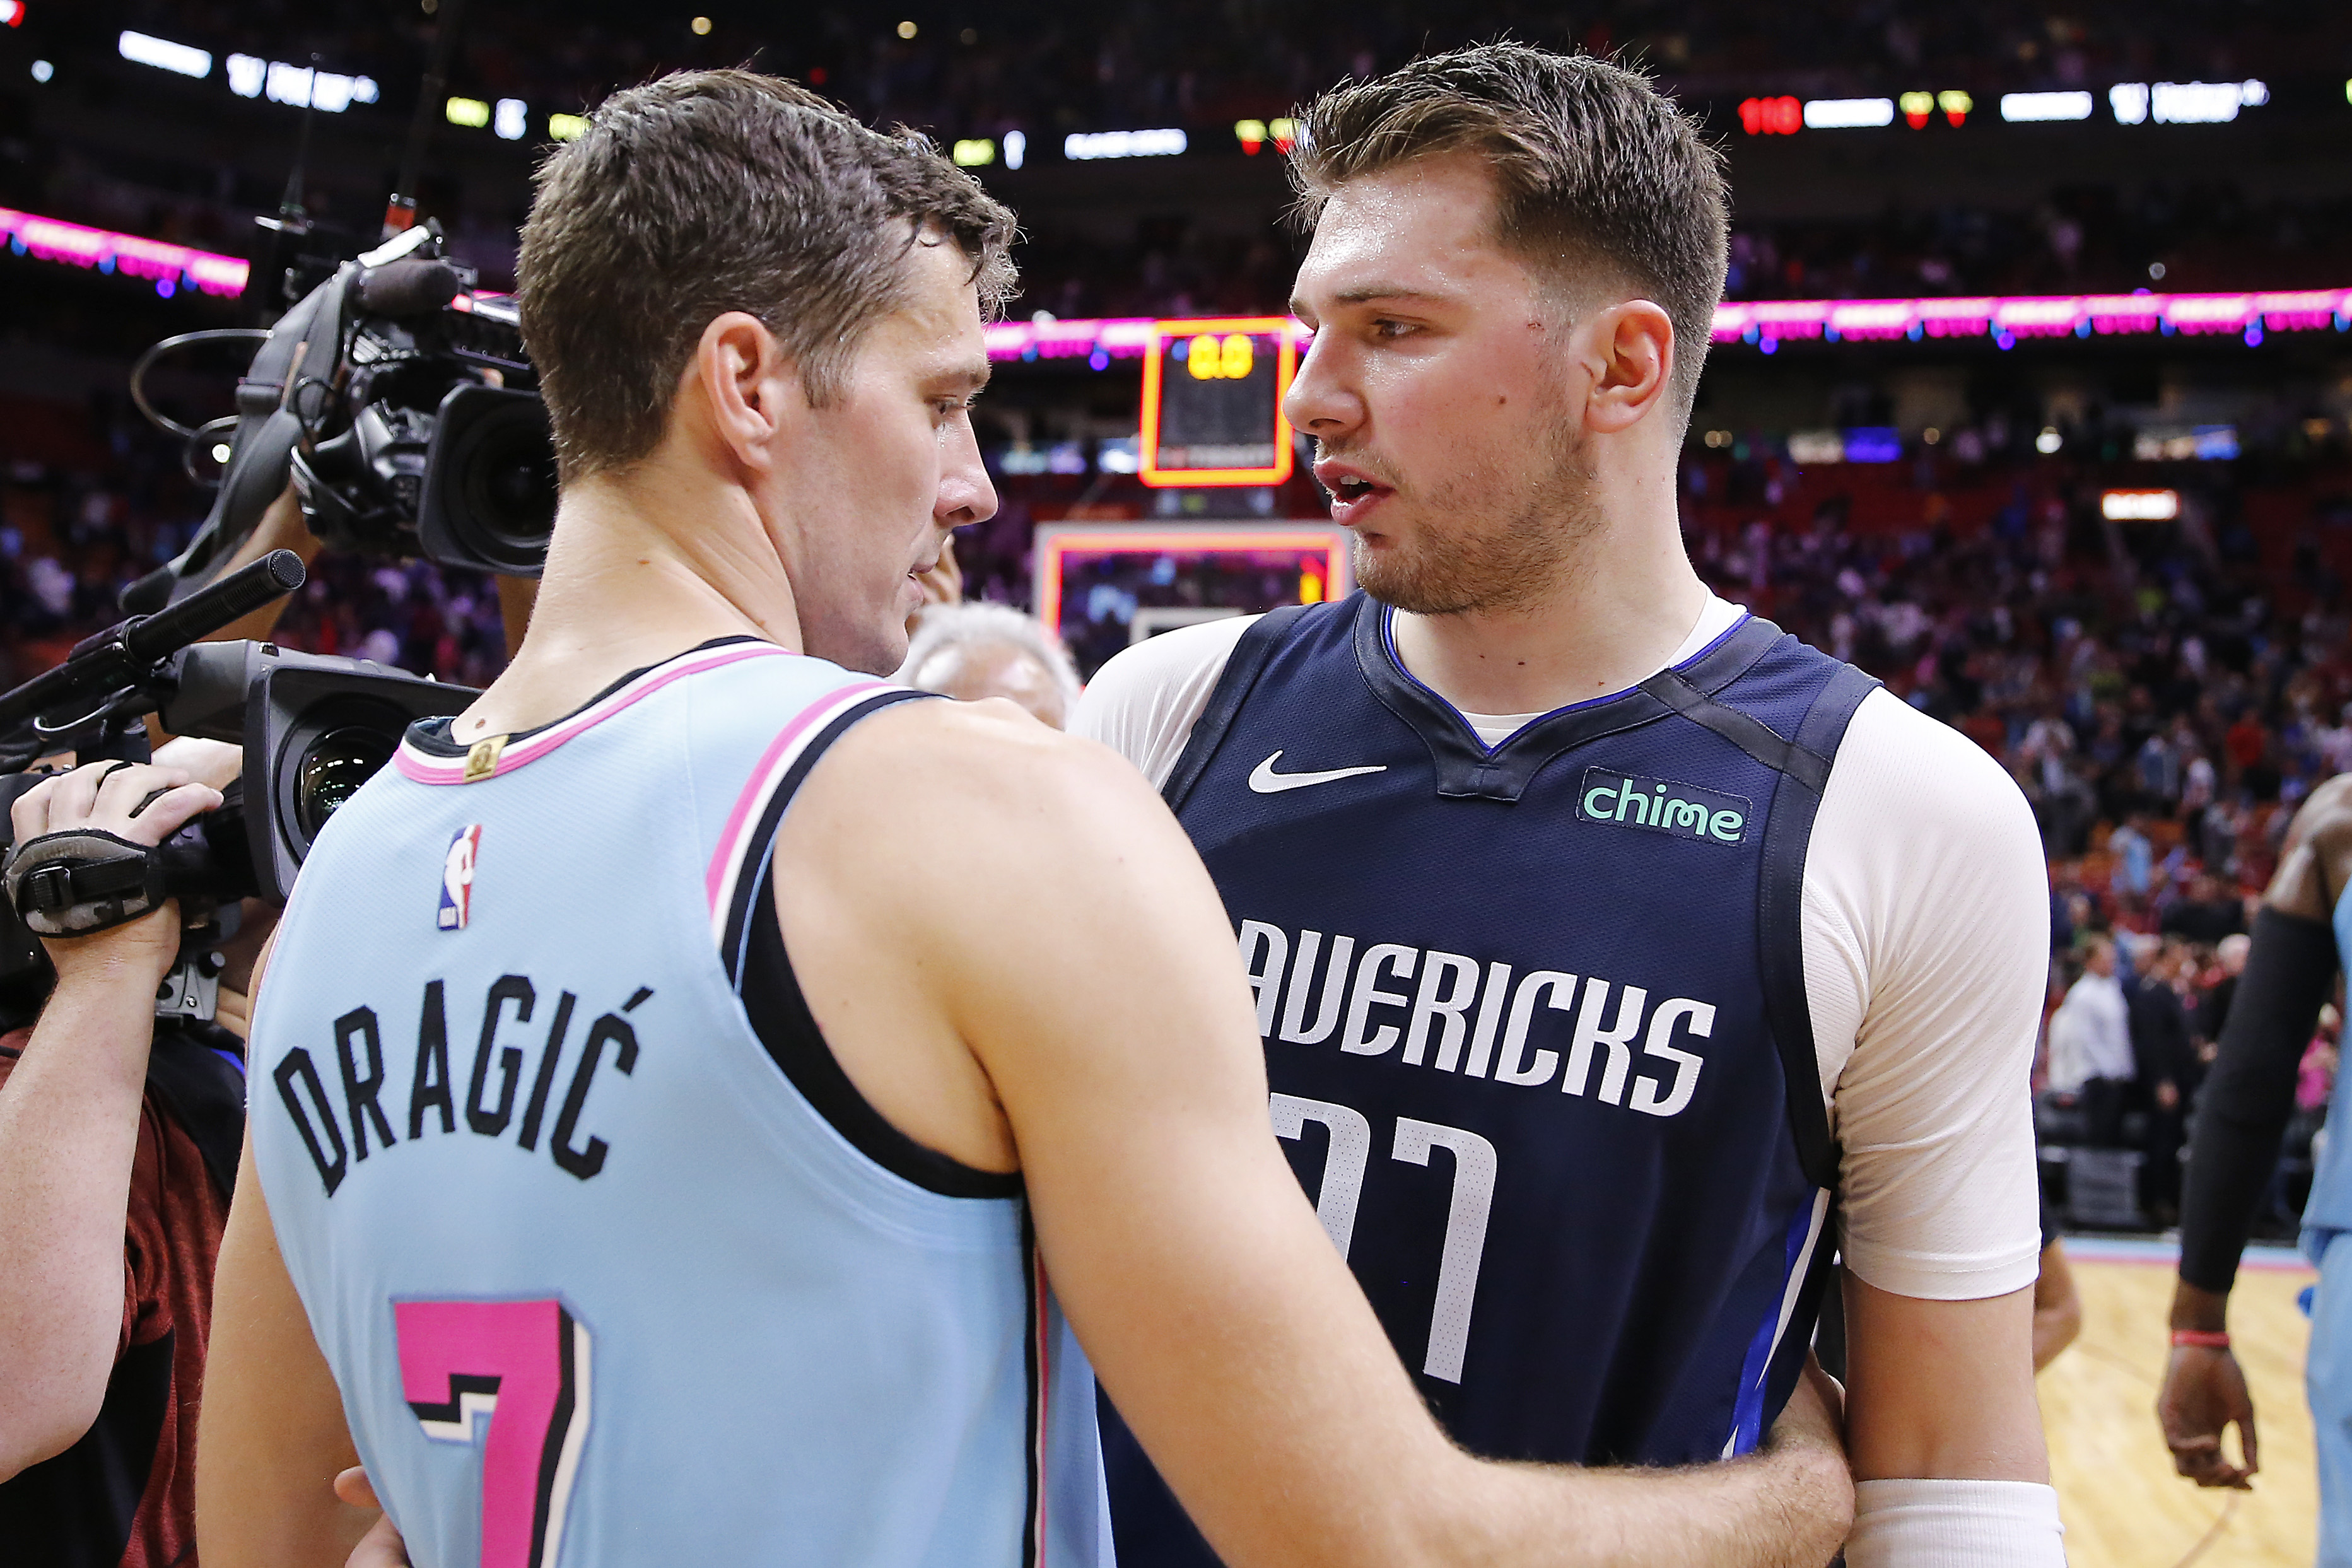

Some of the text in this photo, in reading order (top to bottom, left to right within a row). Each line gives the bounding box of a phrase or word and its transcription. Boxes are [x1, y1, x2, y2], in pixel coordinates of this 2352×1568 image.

[1584, 779, 1743, 842] chime
[273, 974, 655, 1198] DRAGIĆ
[1238, 919, 1717, 1118] AVERICKS
[1268, 1092, 1498, 1384] 77
[392, 1297, 593, 1568] 7
